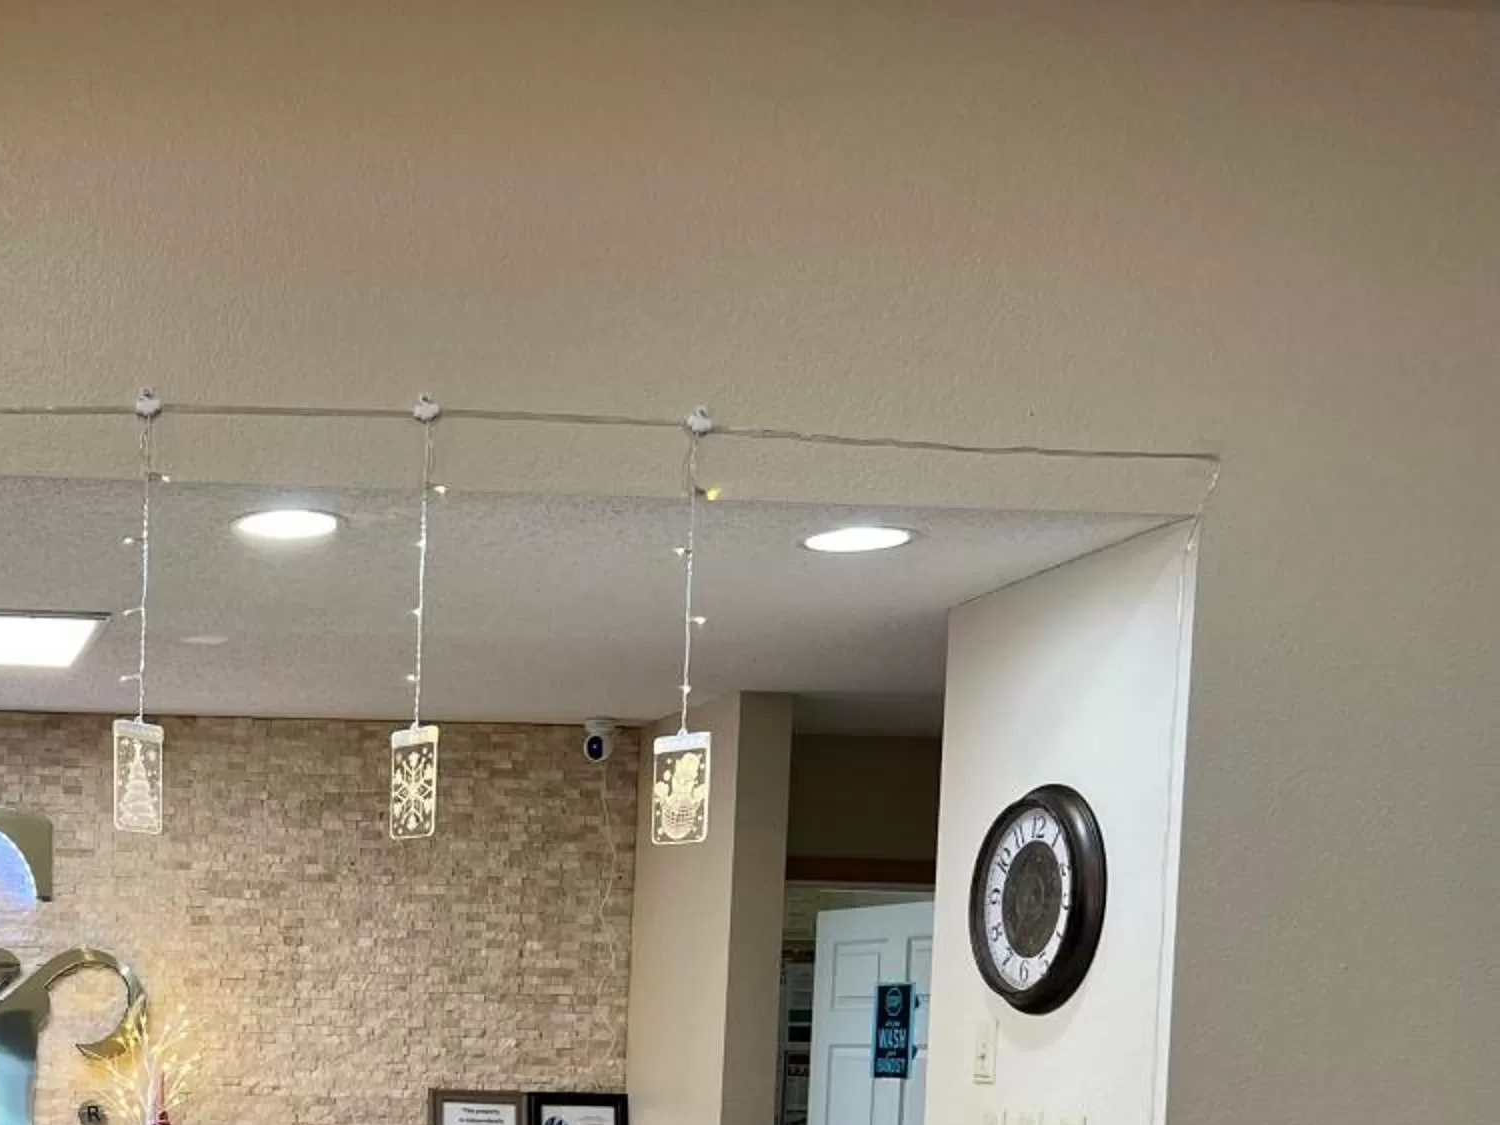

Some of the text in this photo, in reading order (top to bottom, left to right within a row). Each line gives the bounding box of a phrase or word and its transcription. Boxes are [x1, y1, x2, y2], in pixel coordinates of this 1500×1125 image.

[1012, 823, 1025, 848] 11
[1031, 815, 1047, 838] 12
[1019, 959, 1029, 983] 6
[87, 1106, 100, 1121] R
